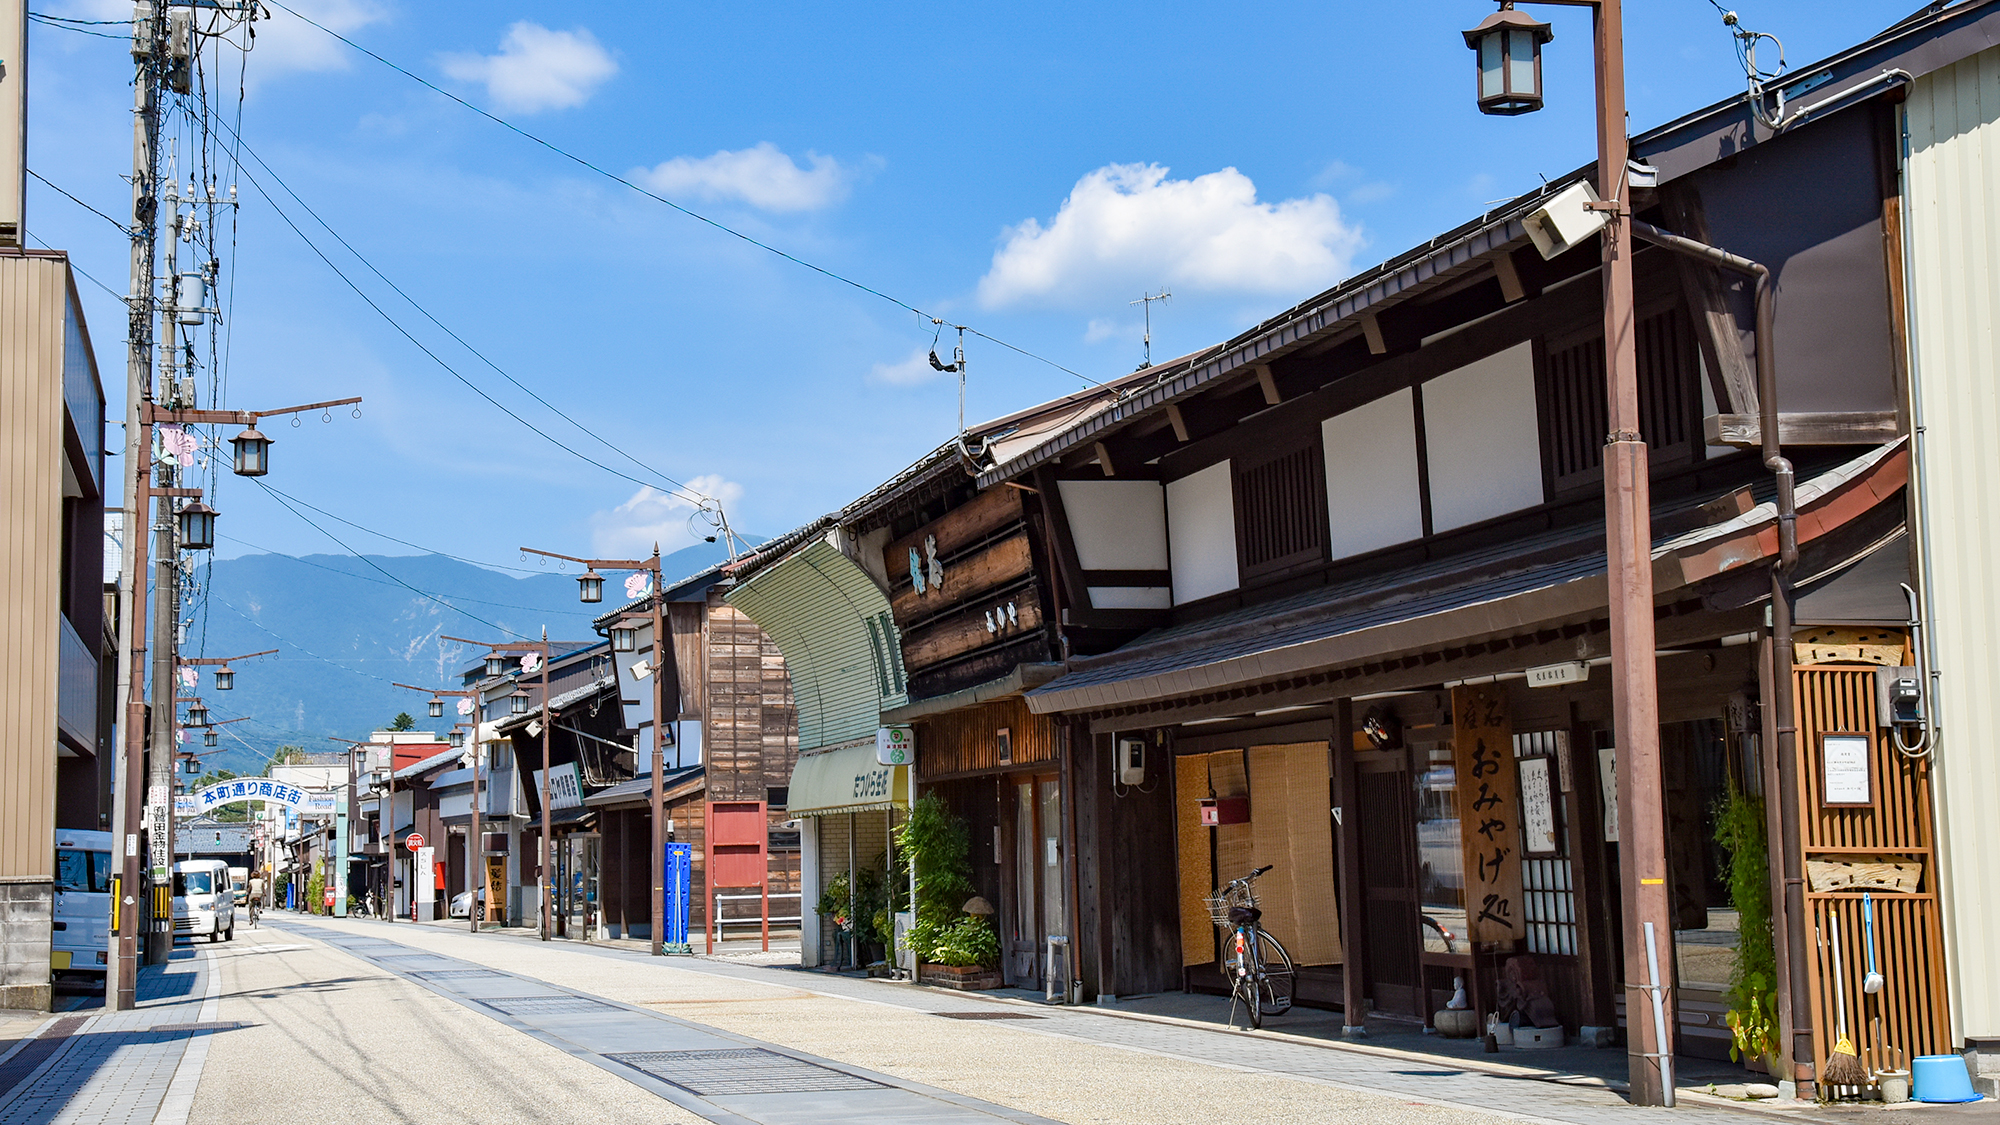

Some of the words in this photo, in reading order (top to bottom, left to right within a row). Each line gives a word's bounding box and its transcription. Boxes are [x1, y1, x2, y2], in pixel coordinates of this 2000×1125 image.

[201, 781, 304, 805] 本町通り商店街
[308, 795, 334, 803] Fashion
[1471, 737, 1513, 929] おみやげ処
